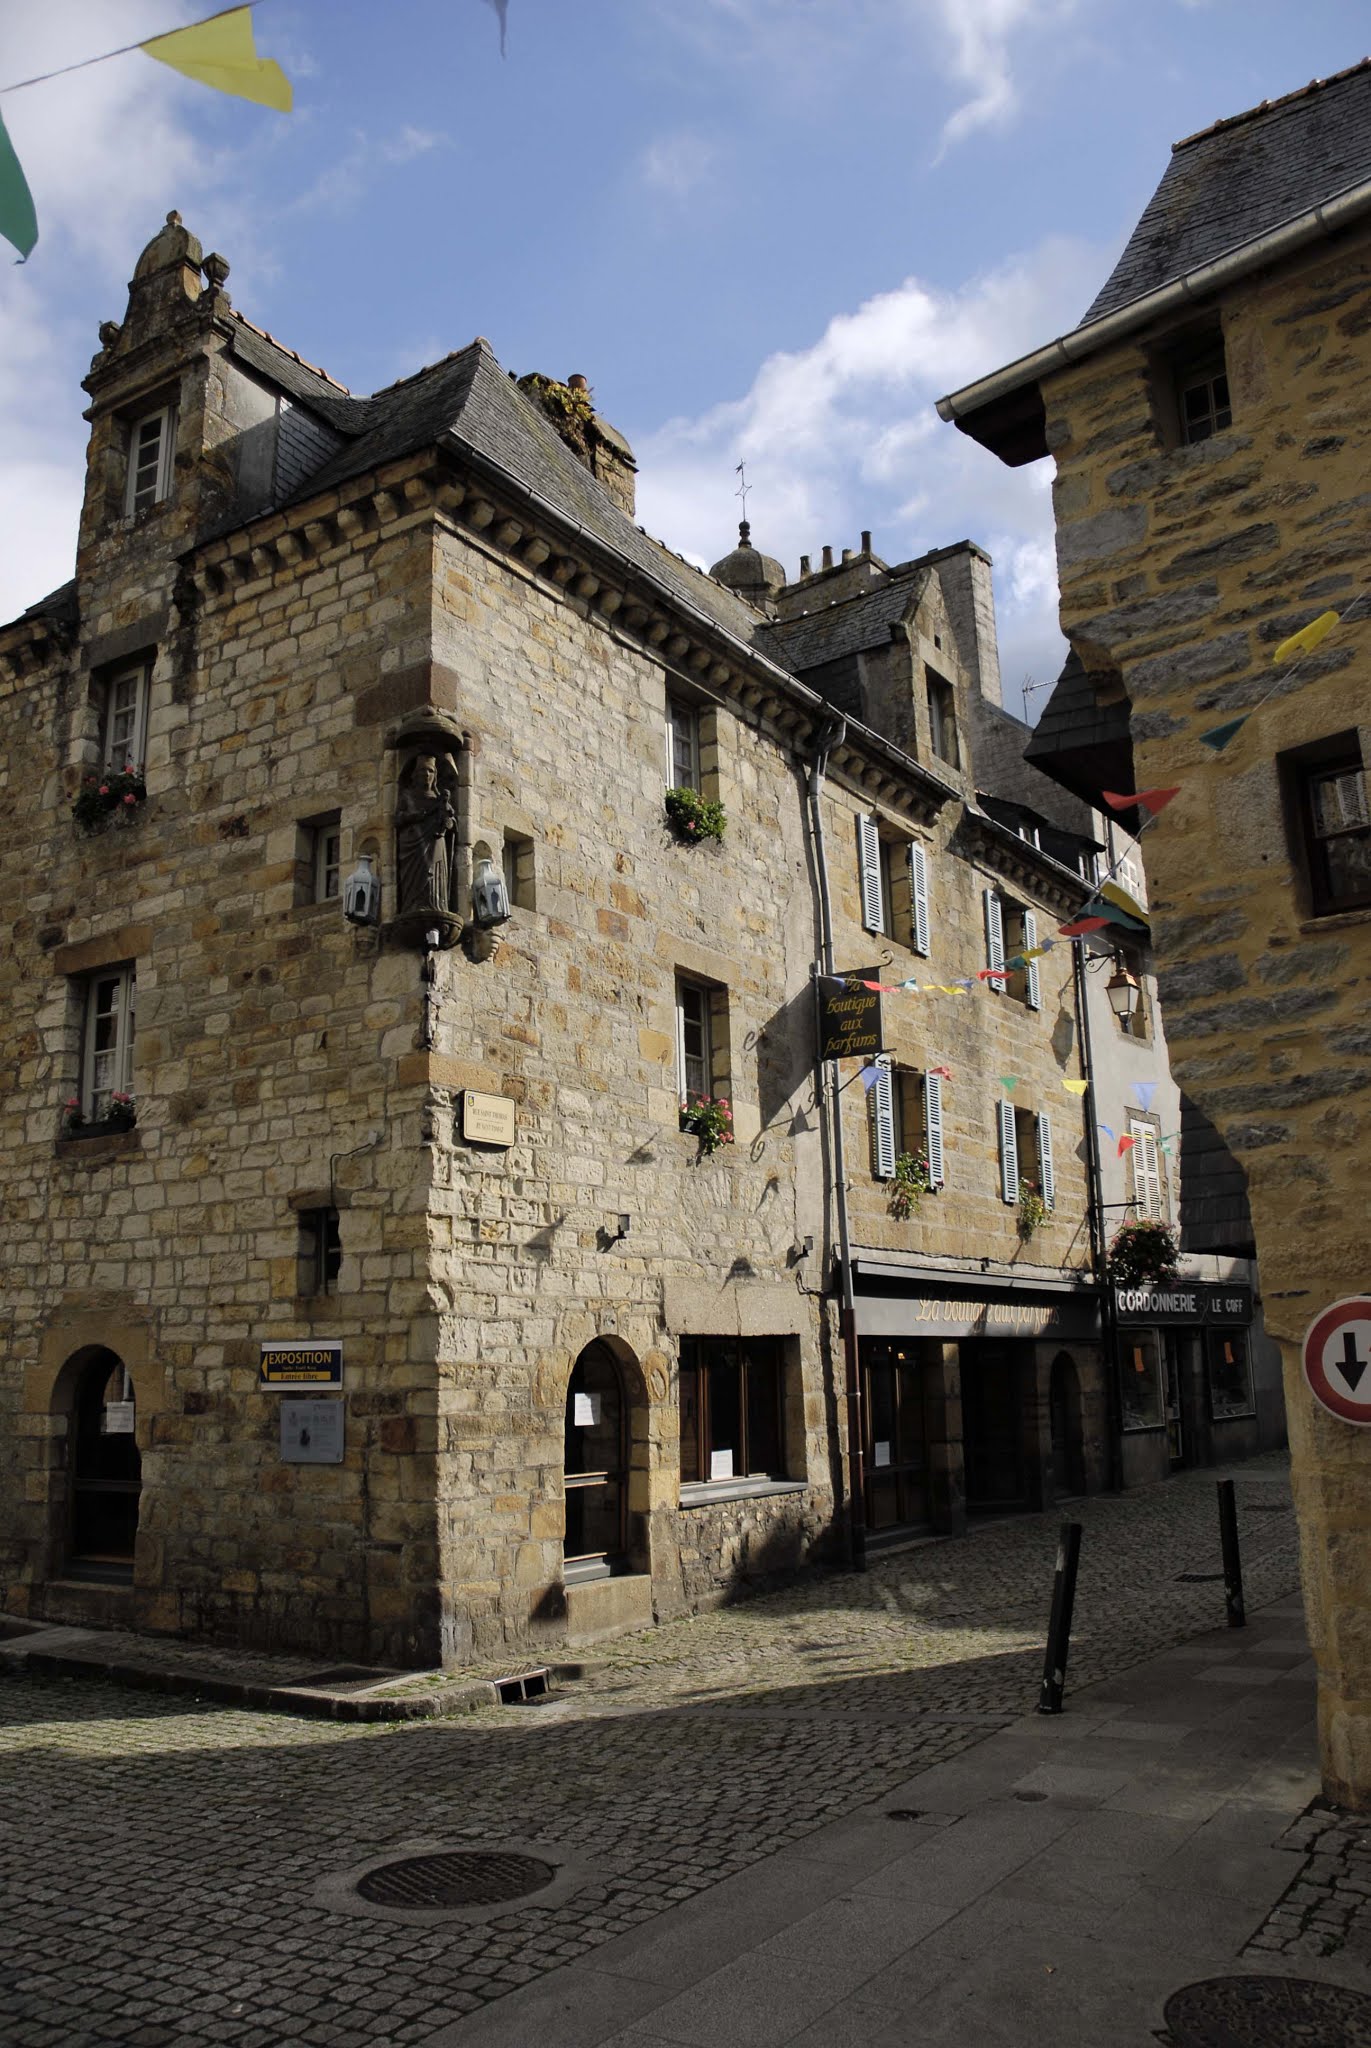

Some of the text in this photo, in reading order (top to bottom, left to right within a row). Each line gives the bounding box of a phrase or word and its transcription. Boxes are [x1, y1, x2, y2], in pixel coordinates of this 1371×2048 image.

[845, 974, 861, 992] La
[827, 996, 876, 1015] boutique
[840, 1018, 863, 1031] aux
[824, 1032, 877, 1057] parfums
[915, 1299, 939, 1322] La
[1118, 1291, 1197, 1313] CORDONNERIE
[1211, 1298, 1222, 1312] LE
[269, 1352, 331, 1364] EXPOSITION
[281, 1372, 301, 1380] Entrée
